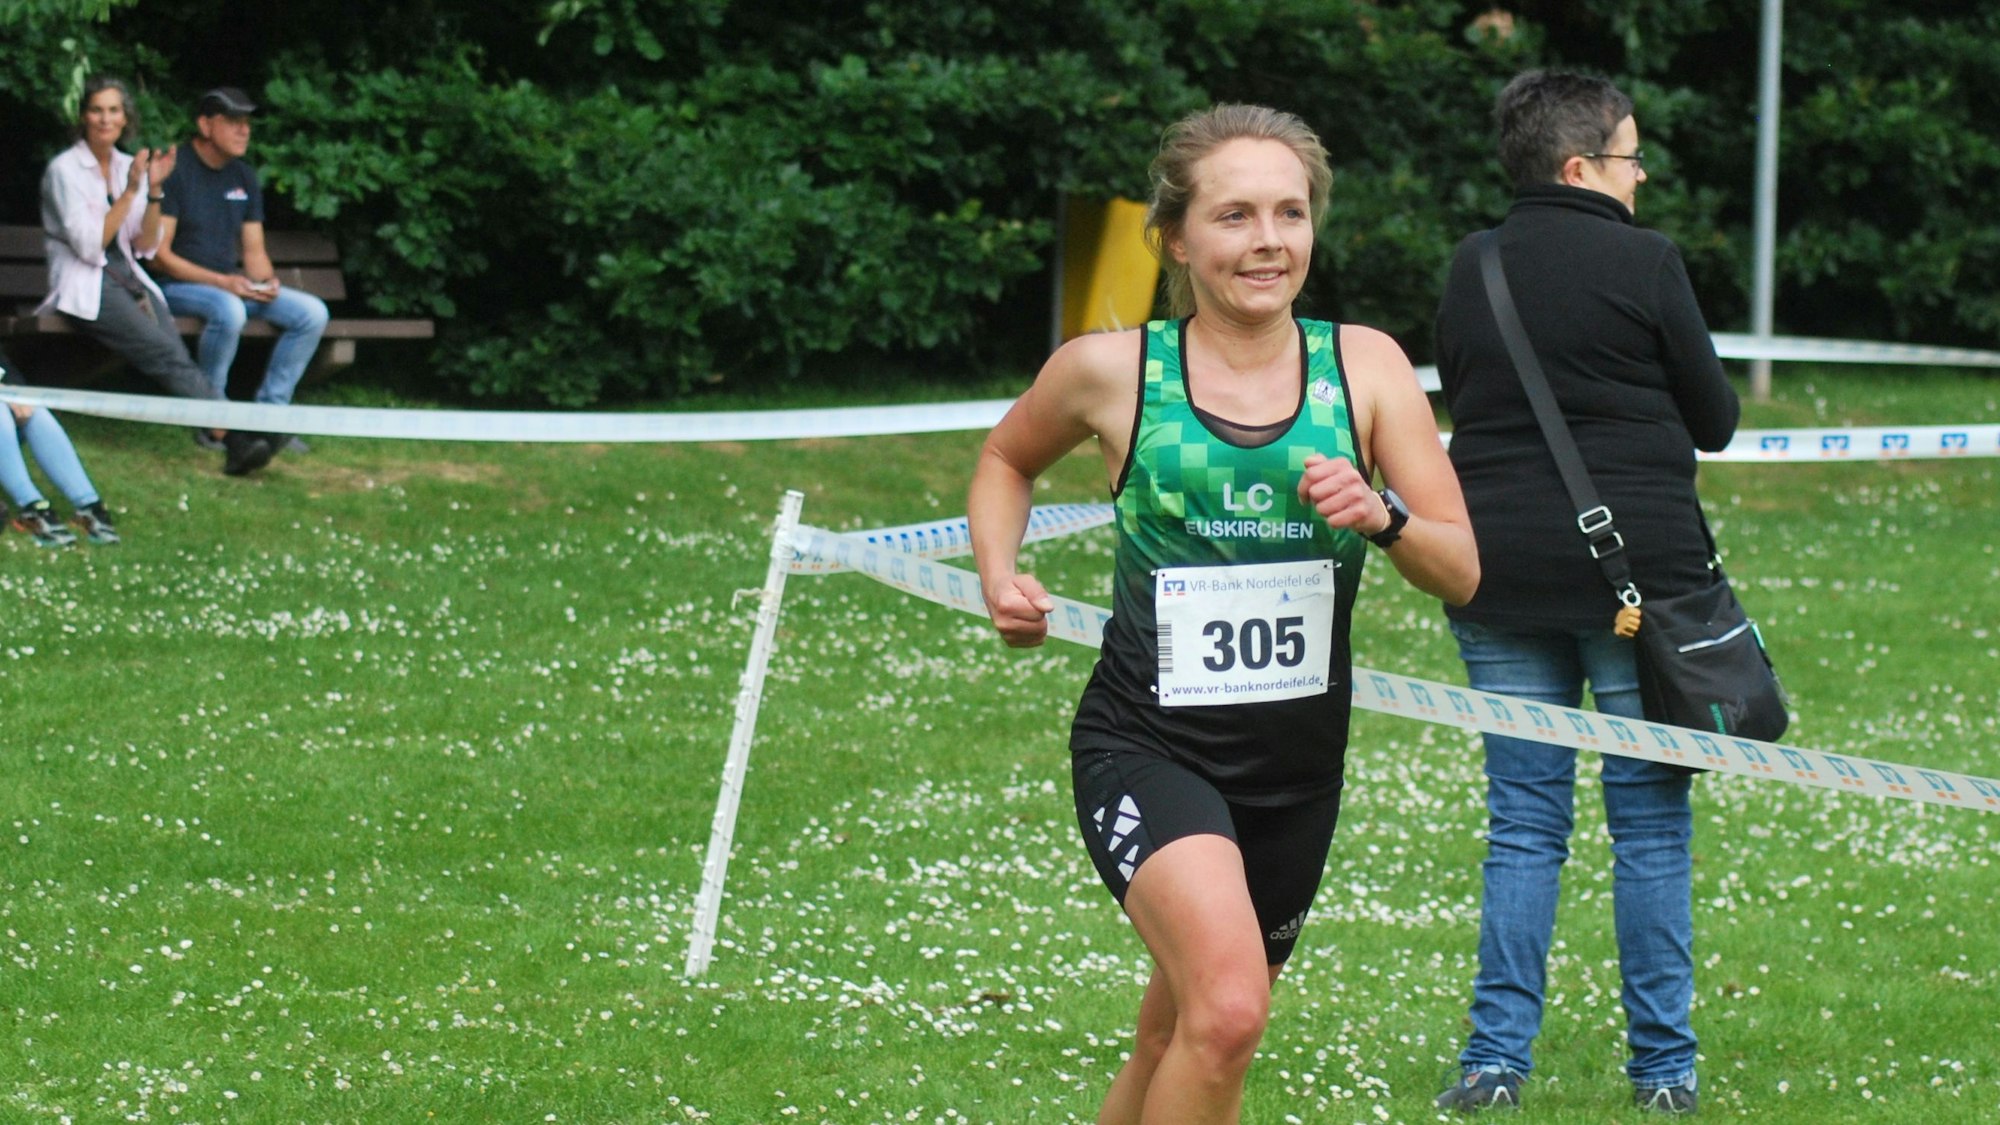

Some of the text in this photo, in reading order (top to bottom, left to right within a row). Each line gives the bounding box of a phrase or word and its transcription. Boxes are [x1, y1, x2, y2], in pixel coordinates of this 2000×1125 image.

[1223, 483, 1273, 512] LC
[1185, 521, 1313, 539] EUSKIRCHEN
[1190, 573, 1320, 593] VR-Bank Nordeifel eG
[1202, 616, 1306, 673] 305
[1172, 675, 1320, 695] www.vr-banknordeifel.de
